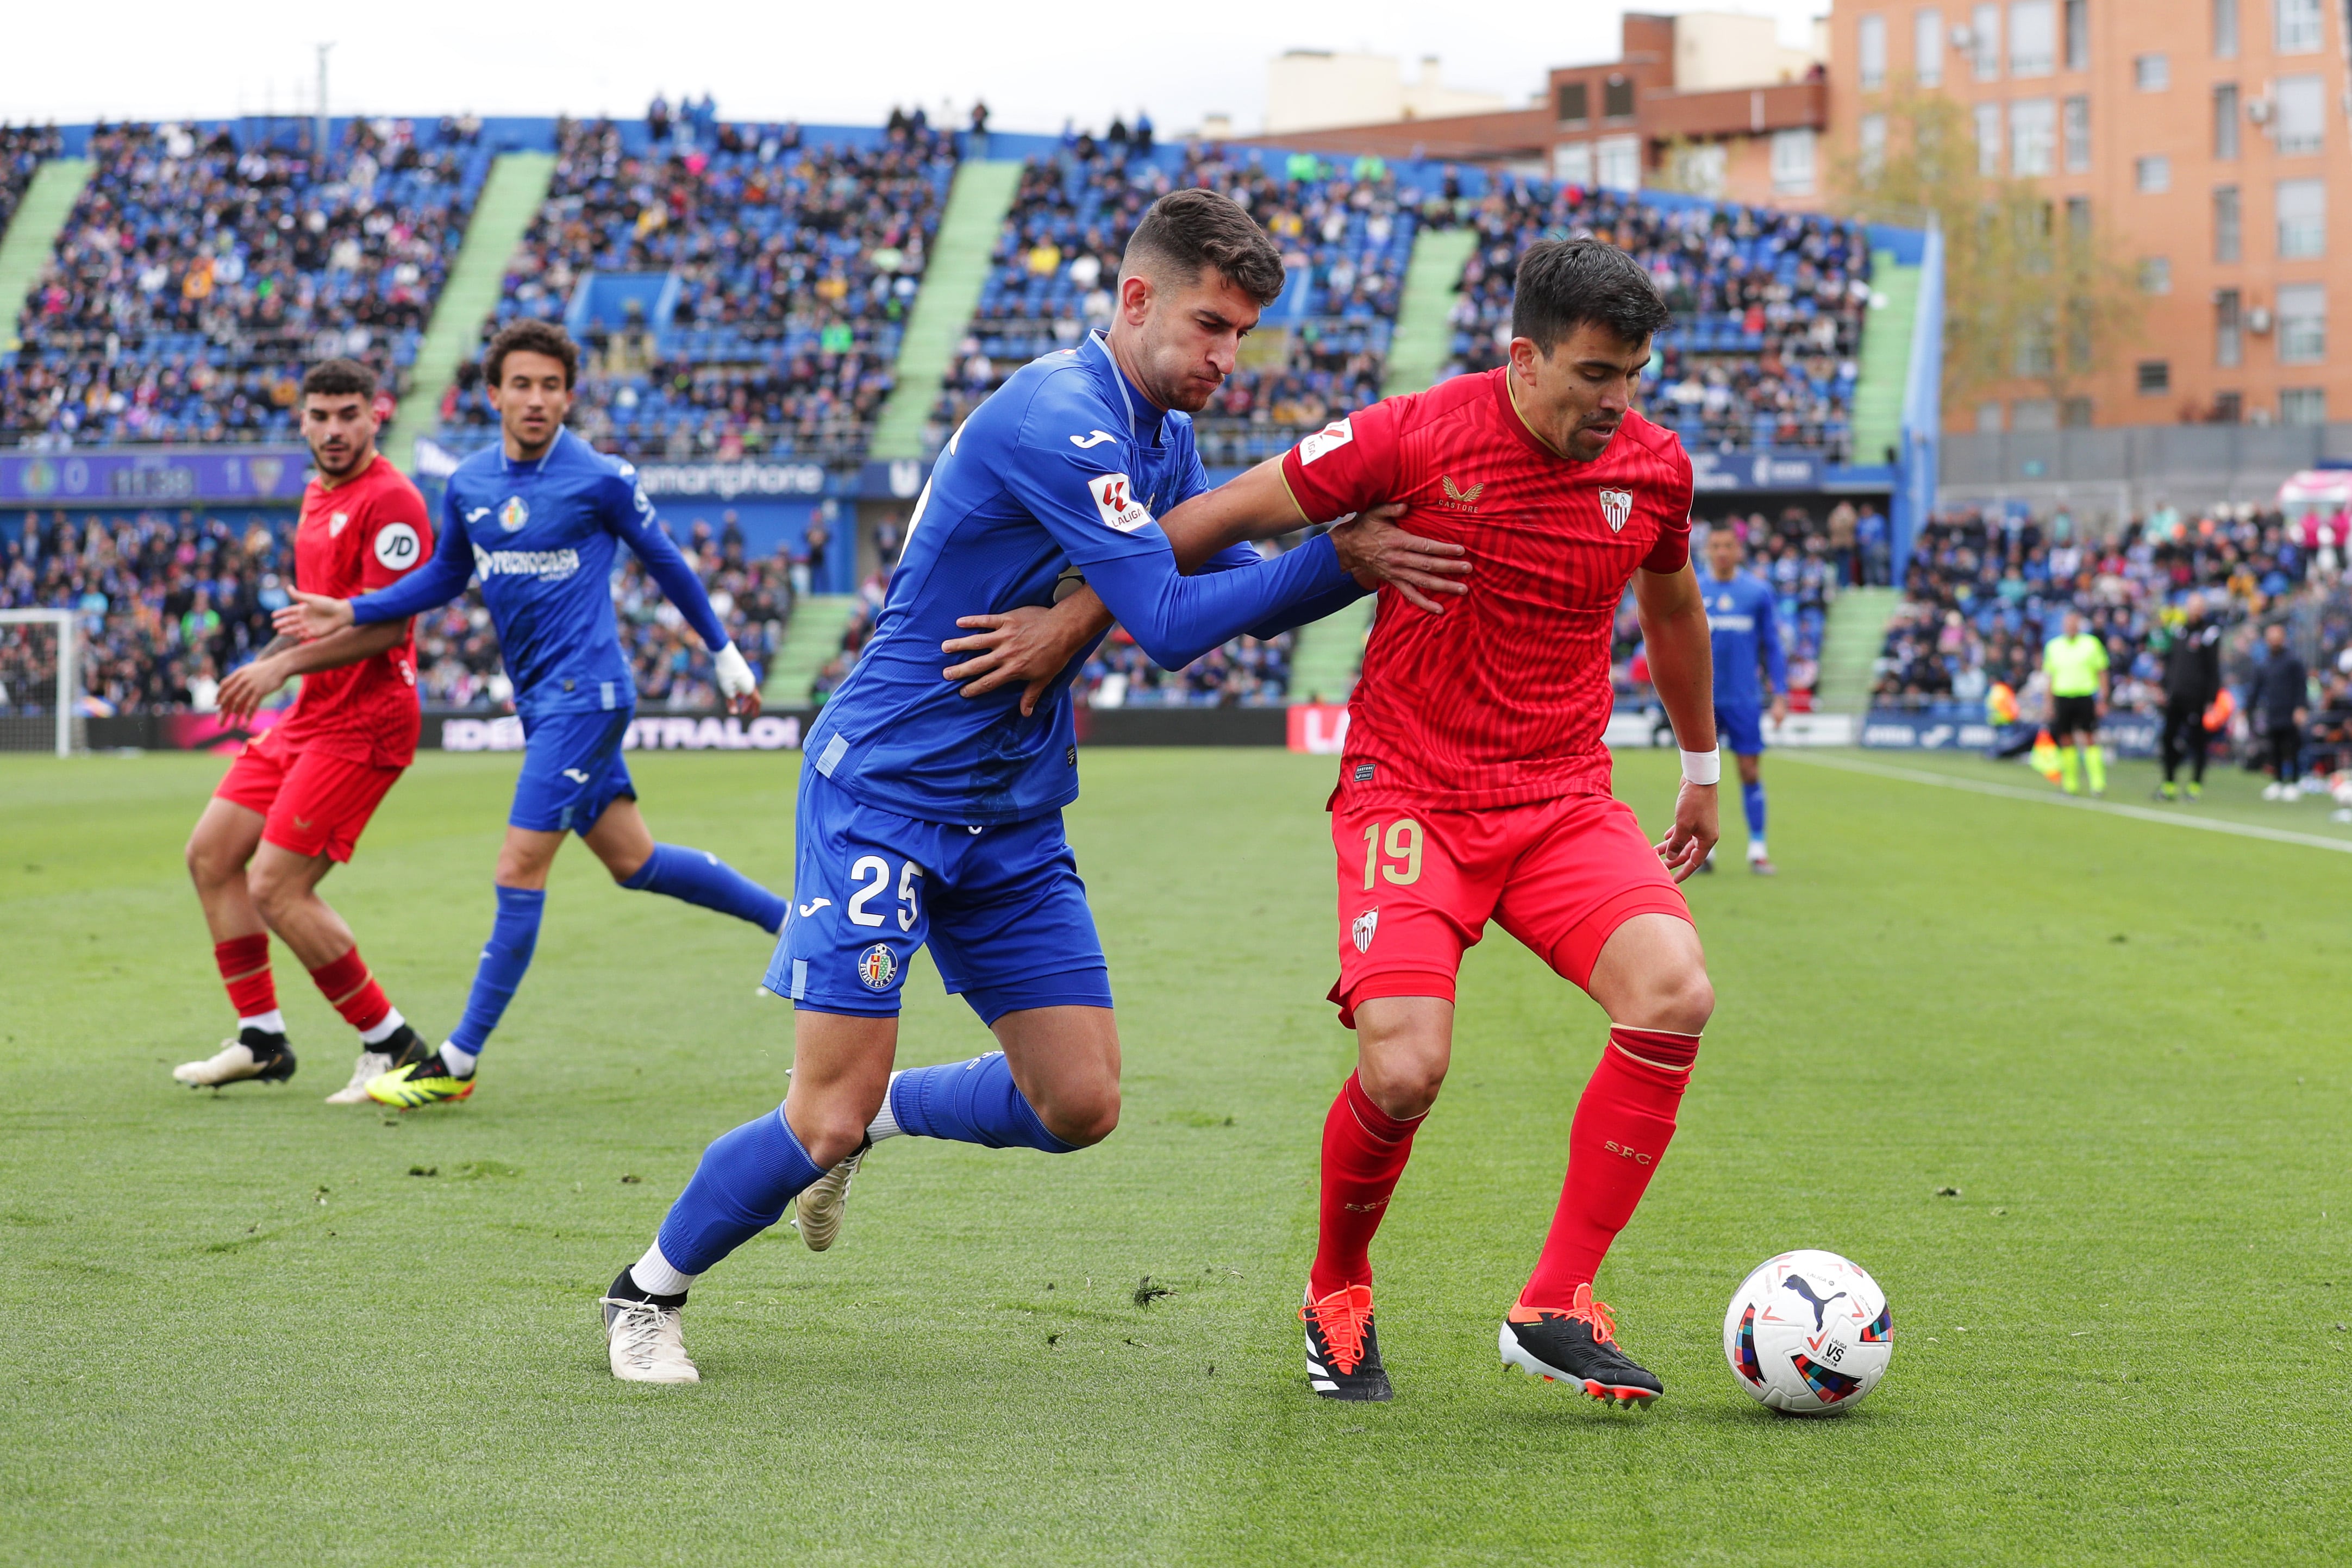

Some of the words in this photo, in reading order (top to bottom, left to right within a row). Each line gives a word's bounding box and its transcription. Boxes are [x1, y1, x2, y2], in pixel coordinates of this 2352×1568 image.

[63, 458, 89, 494] 0
[223, 458, 241, 492] 1
[640, 459, 824, 500] smartphone
[1111, 509, 1144, 527] LALIGA
[1438, 499, 1479, 513] CASTORE
[383, 536, 413, 556] JD
[1363, 818, 1423, 891] 19
[848, 855, 923, 932] 25
[860, 963, 873, 985] GETAFE
[1604, 1140, 1652, 1165] SFC
[1826, 1343, 1844, 1363] VS
